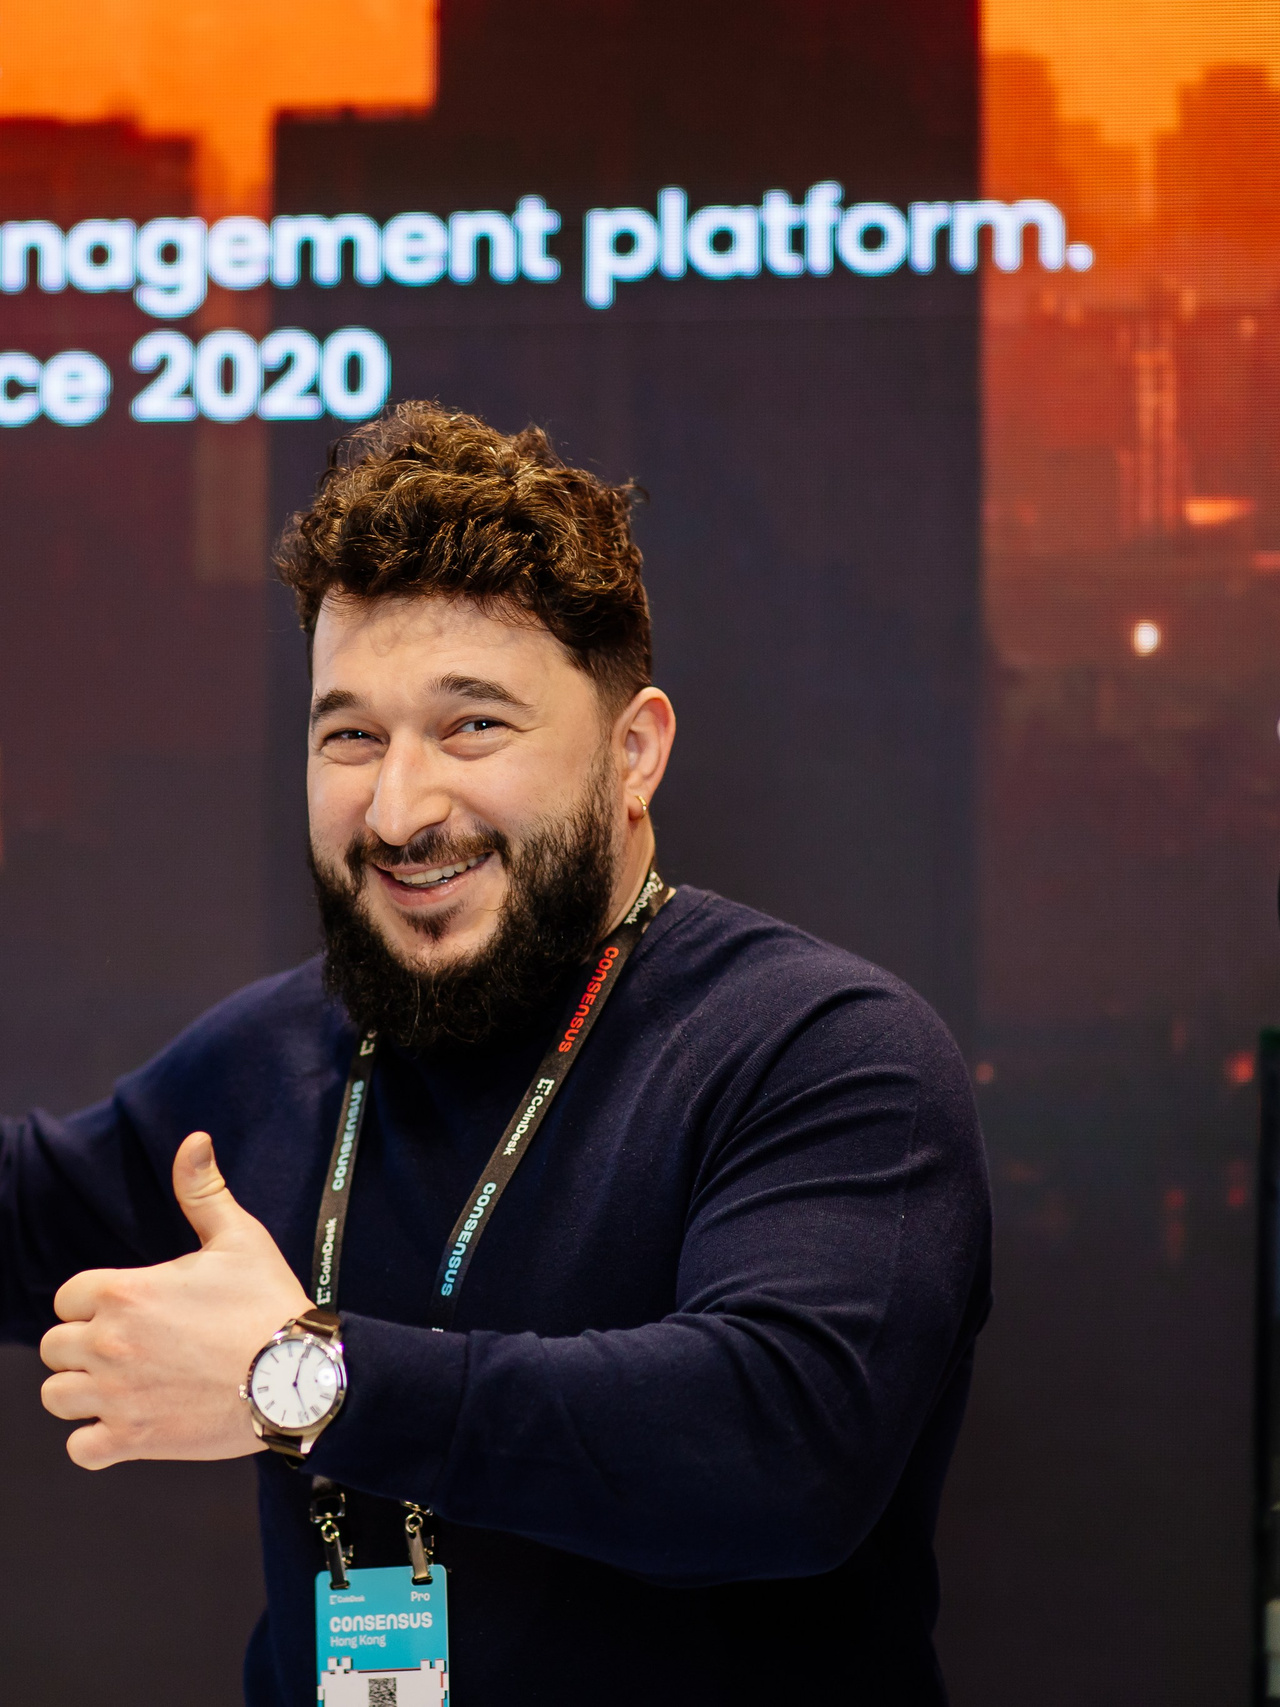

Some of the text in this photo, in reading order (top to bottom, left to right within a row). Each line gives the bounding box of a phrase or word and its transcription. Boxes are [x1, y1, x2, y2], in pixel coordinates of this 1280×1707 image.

[583, 181, 1096, 309] platform.
[129, 326, 391, 423] 2020
[503, 1095, 544, 1156] CoinDesk
[319, 1217, 337, 1286] CoinDesk
[410, 1591, 431, 1602] Pro
[330, 1635, 386, 1649] Hong Kong
